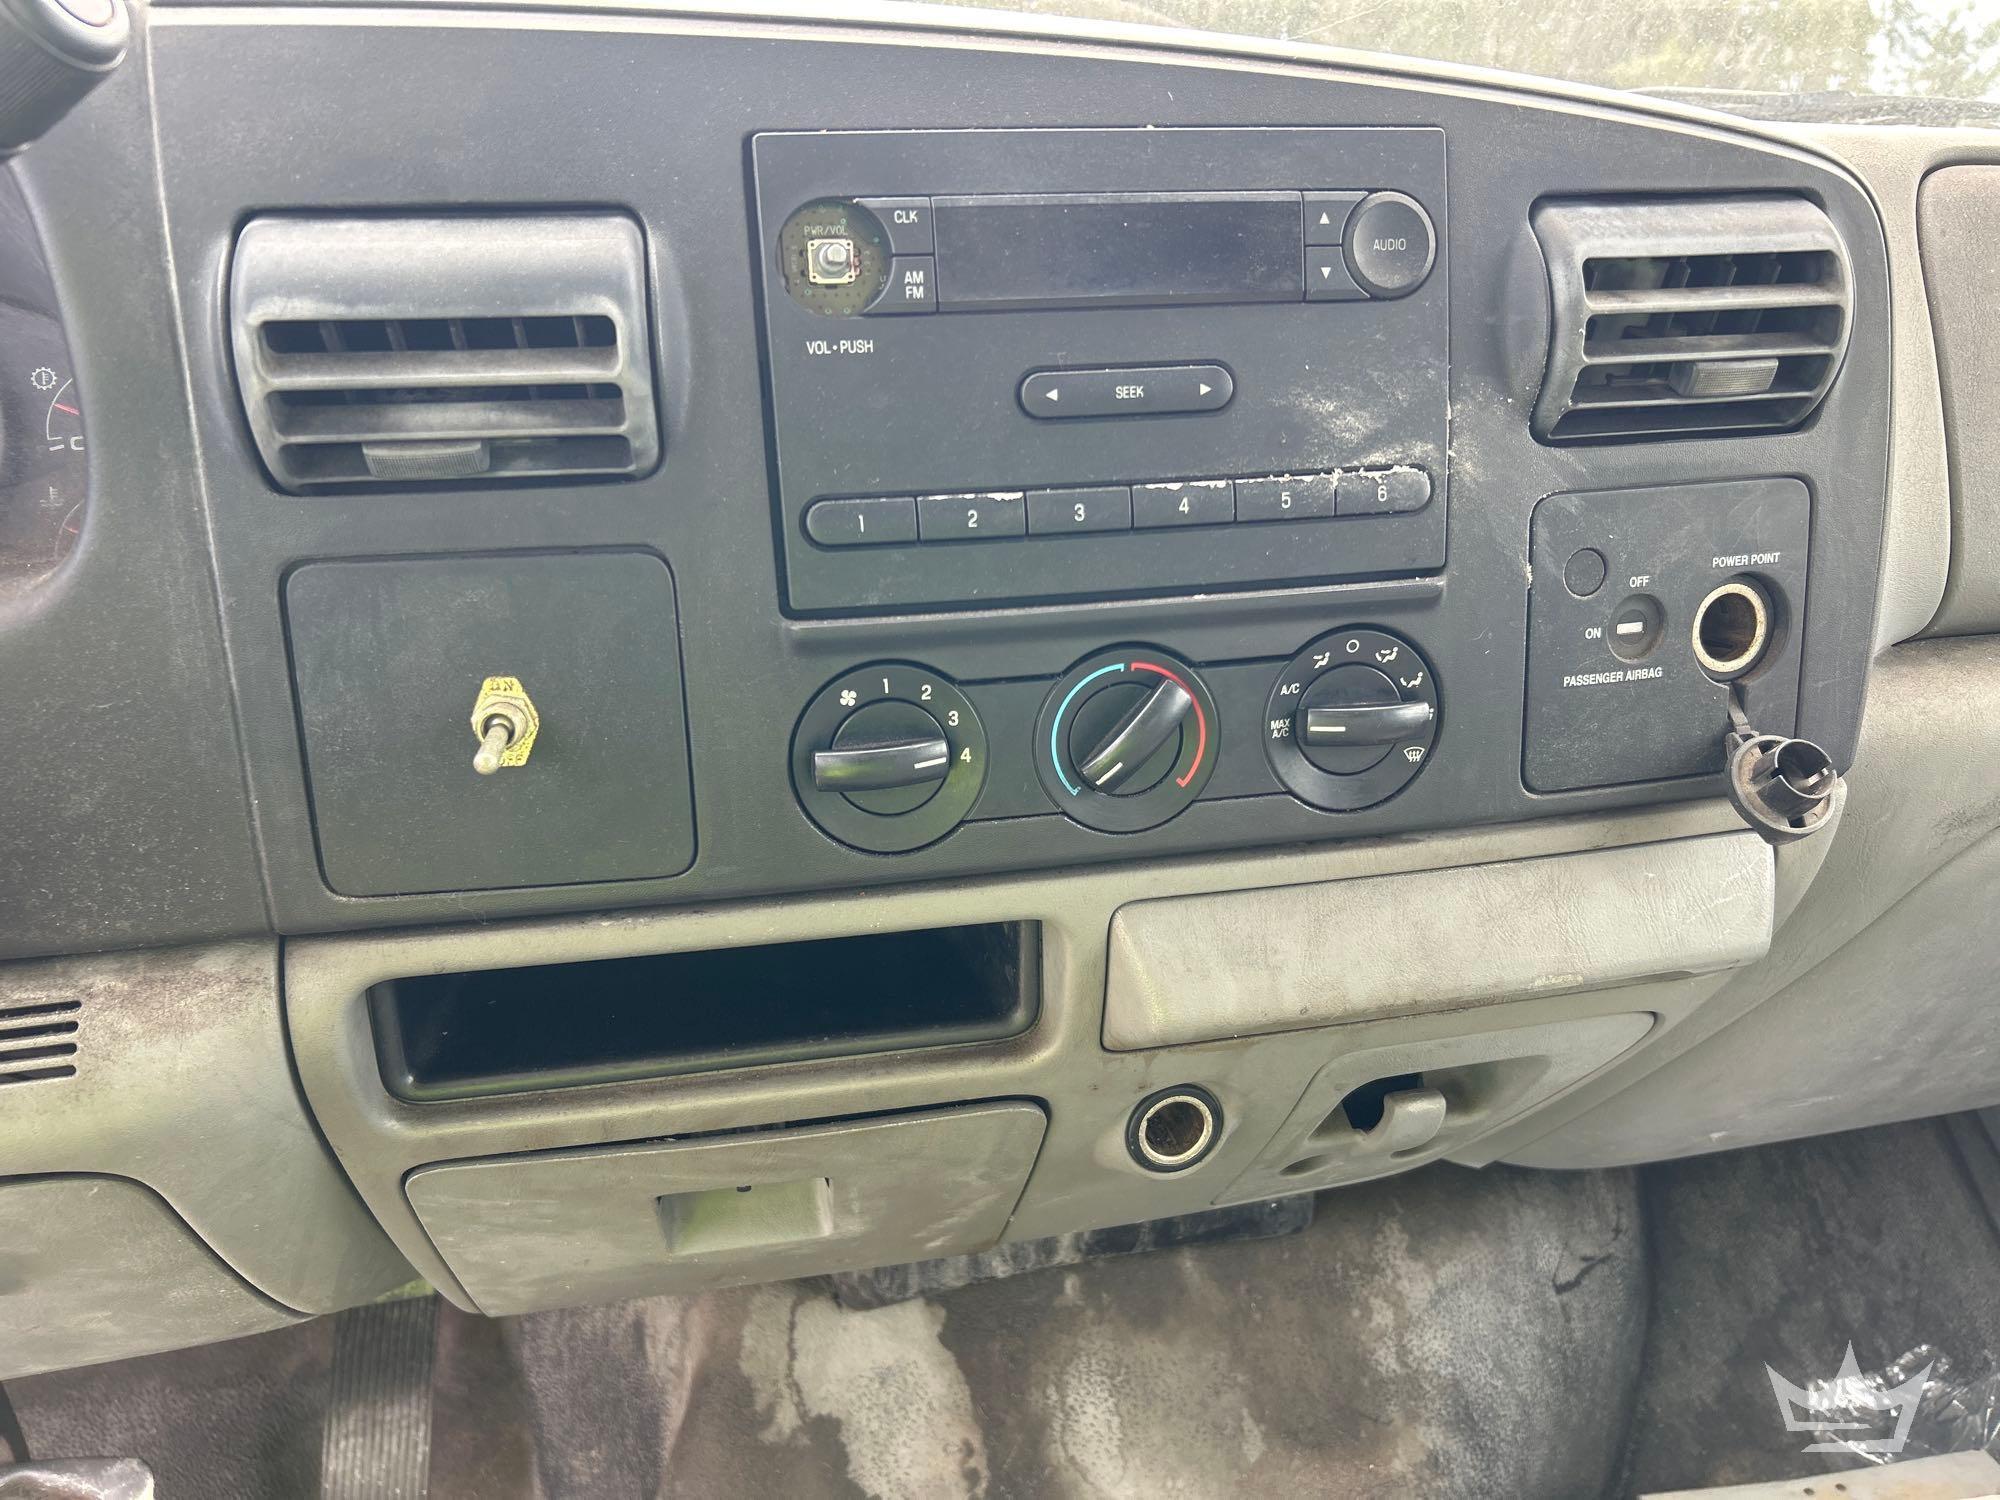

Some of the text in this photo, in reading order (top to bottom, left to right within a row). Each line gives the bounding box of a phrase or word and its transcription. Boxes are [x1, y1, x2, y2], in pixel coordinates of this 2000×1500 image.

[894, 210, 918, 224] CLK
[803, 225, 849, 236] PWR/VOL
[1372, 238, 1407, 251] AUDIO
[904, 271, 924, 284] AM
[905, 286, 924, 299] FM
[1115, 385, 1144, 399] SEEK
[1281, 491, 1291, 509] 5
[1377, 484, 1387, 502] 6
[1074, 503, 1085, 522] 3
[1178, 496, 1190, 514] 4
[858, 514, 865, 532] 1
[967, 509, 978, 528] 2
[1712, 552, 1780, 569] POWER POINT
[1629, 575, 1650, 588] OFF
[1585, 628, 1602, 640] ON
[1563, 666, 1663, 688] PASSENGER AIRBAG
[882, 677, 889, 694] 1
[921, 684, 932, 700] 2
[1280, 682, 1300, 696] A/C
[948, 710, 959, 726] 3
[1270, 718, 1291, 730] MAX
[1272, 728, 1289, 739] A/C
[960, 747, 972, 763] 4
